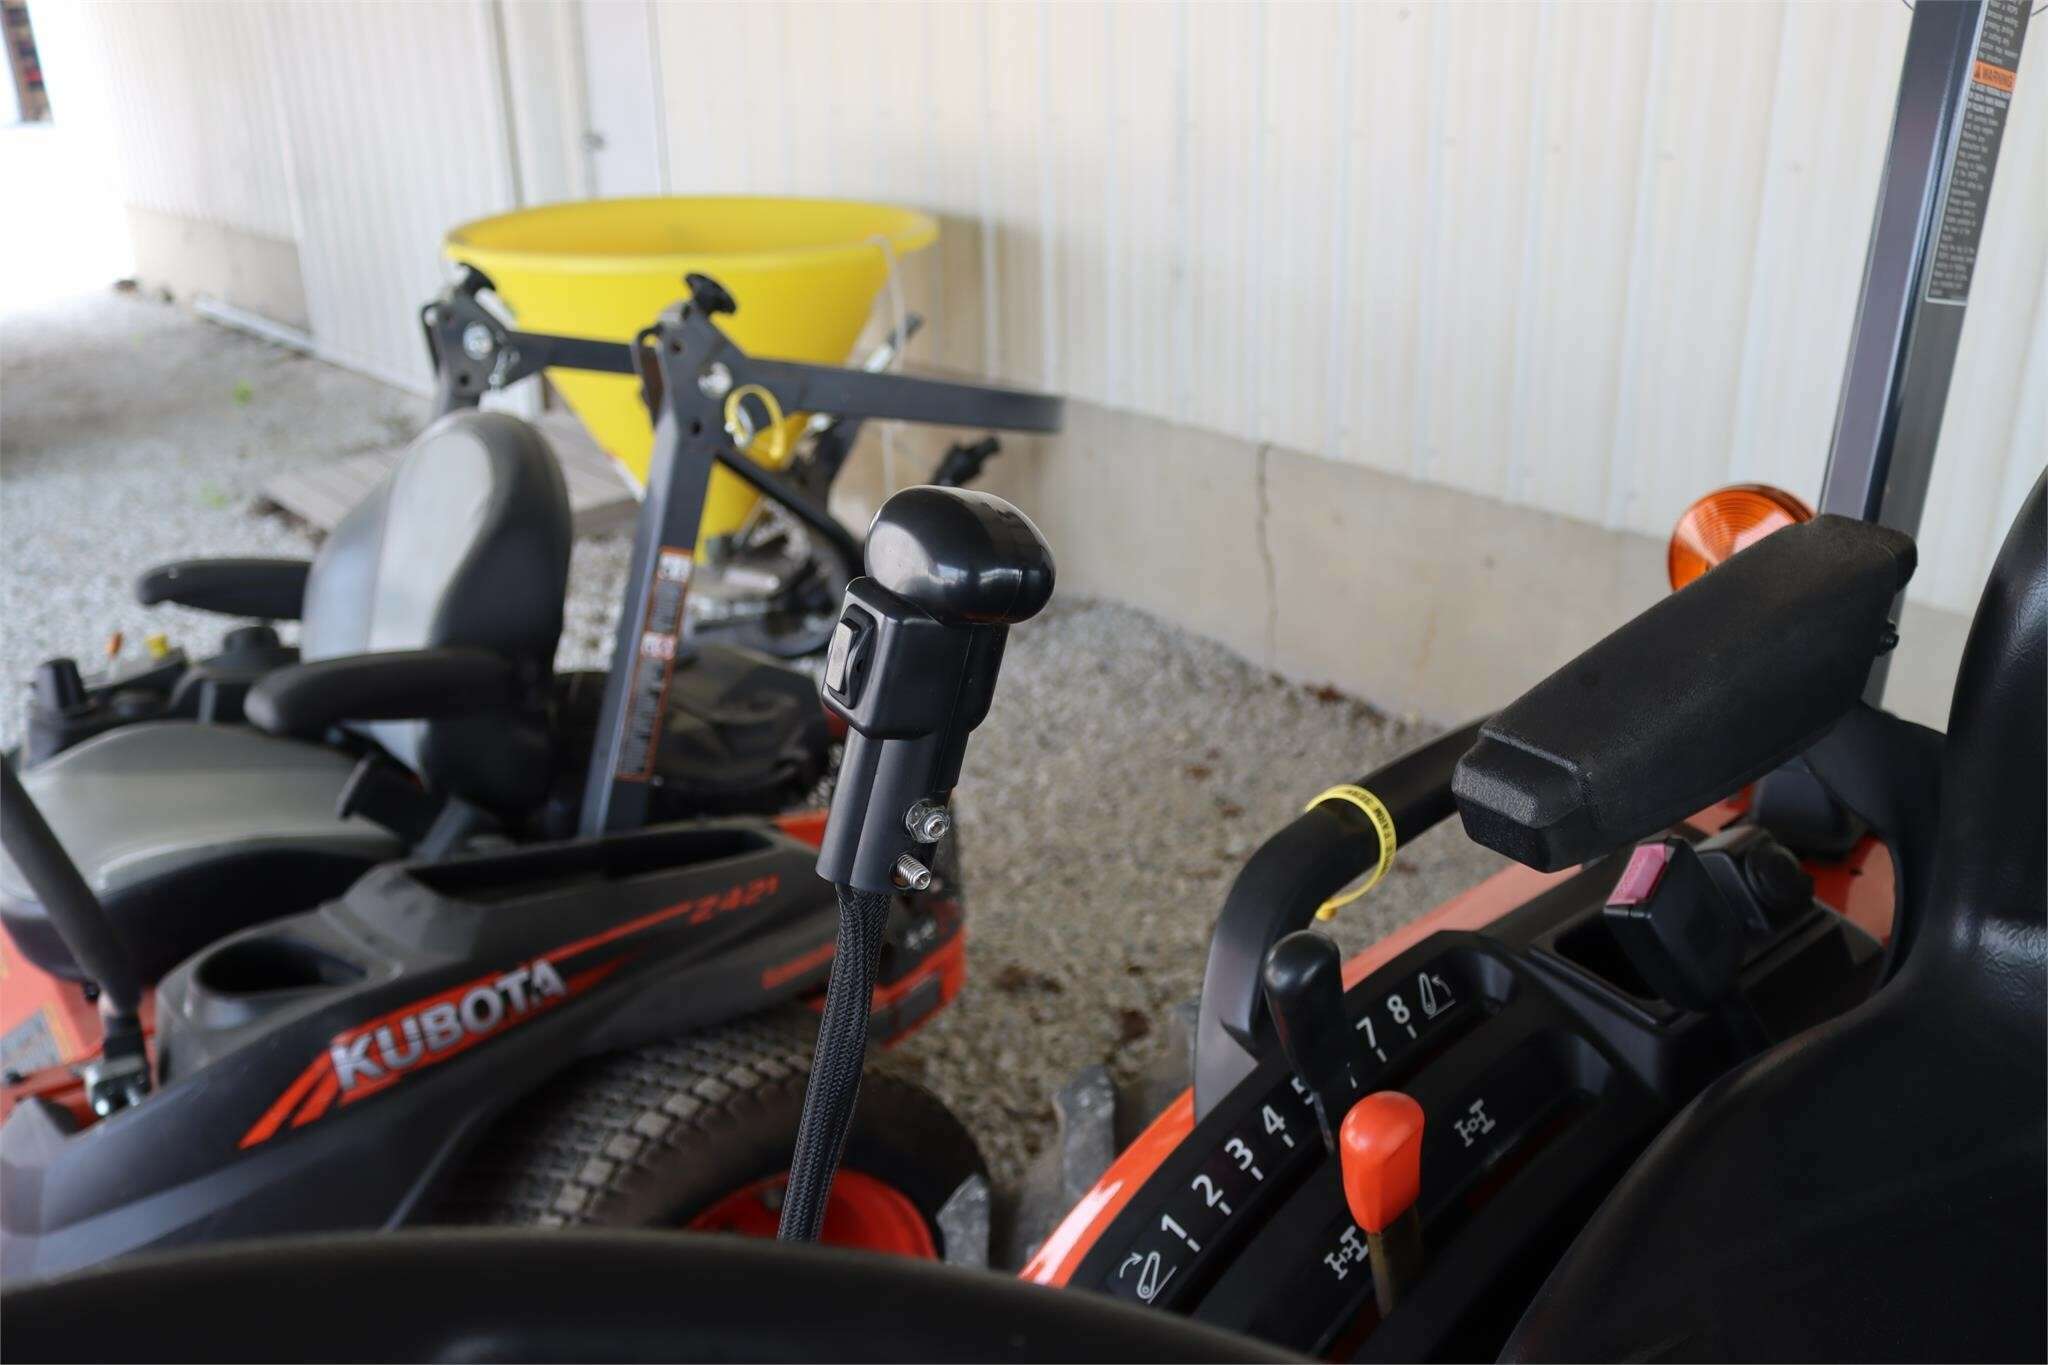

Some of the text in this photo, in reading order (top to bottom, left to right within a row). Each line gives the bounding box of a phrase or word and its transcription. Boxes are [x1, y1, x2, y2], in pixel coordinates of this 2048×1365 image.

[329, 957, 567, 1092] KUBOTA
[1160, 1213, 1188, 1240] 1
[1191, 1174, 1224, 1208] 2
[1224, 1137, 1254, 1171] 3
[1262, 1104, 1286, 1134] 4
[1355, 1016, 1377, 1049] 7
[1386, 994, 1410, 1024] 8
